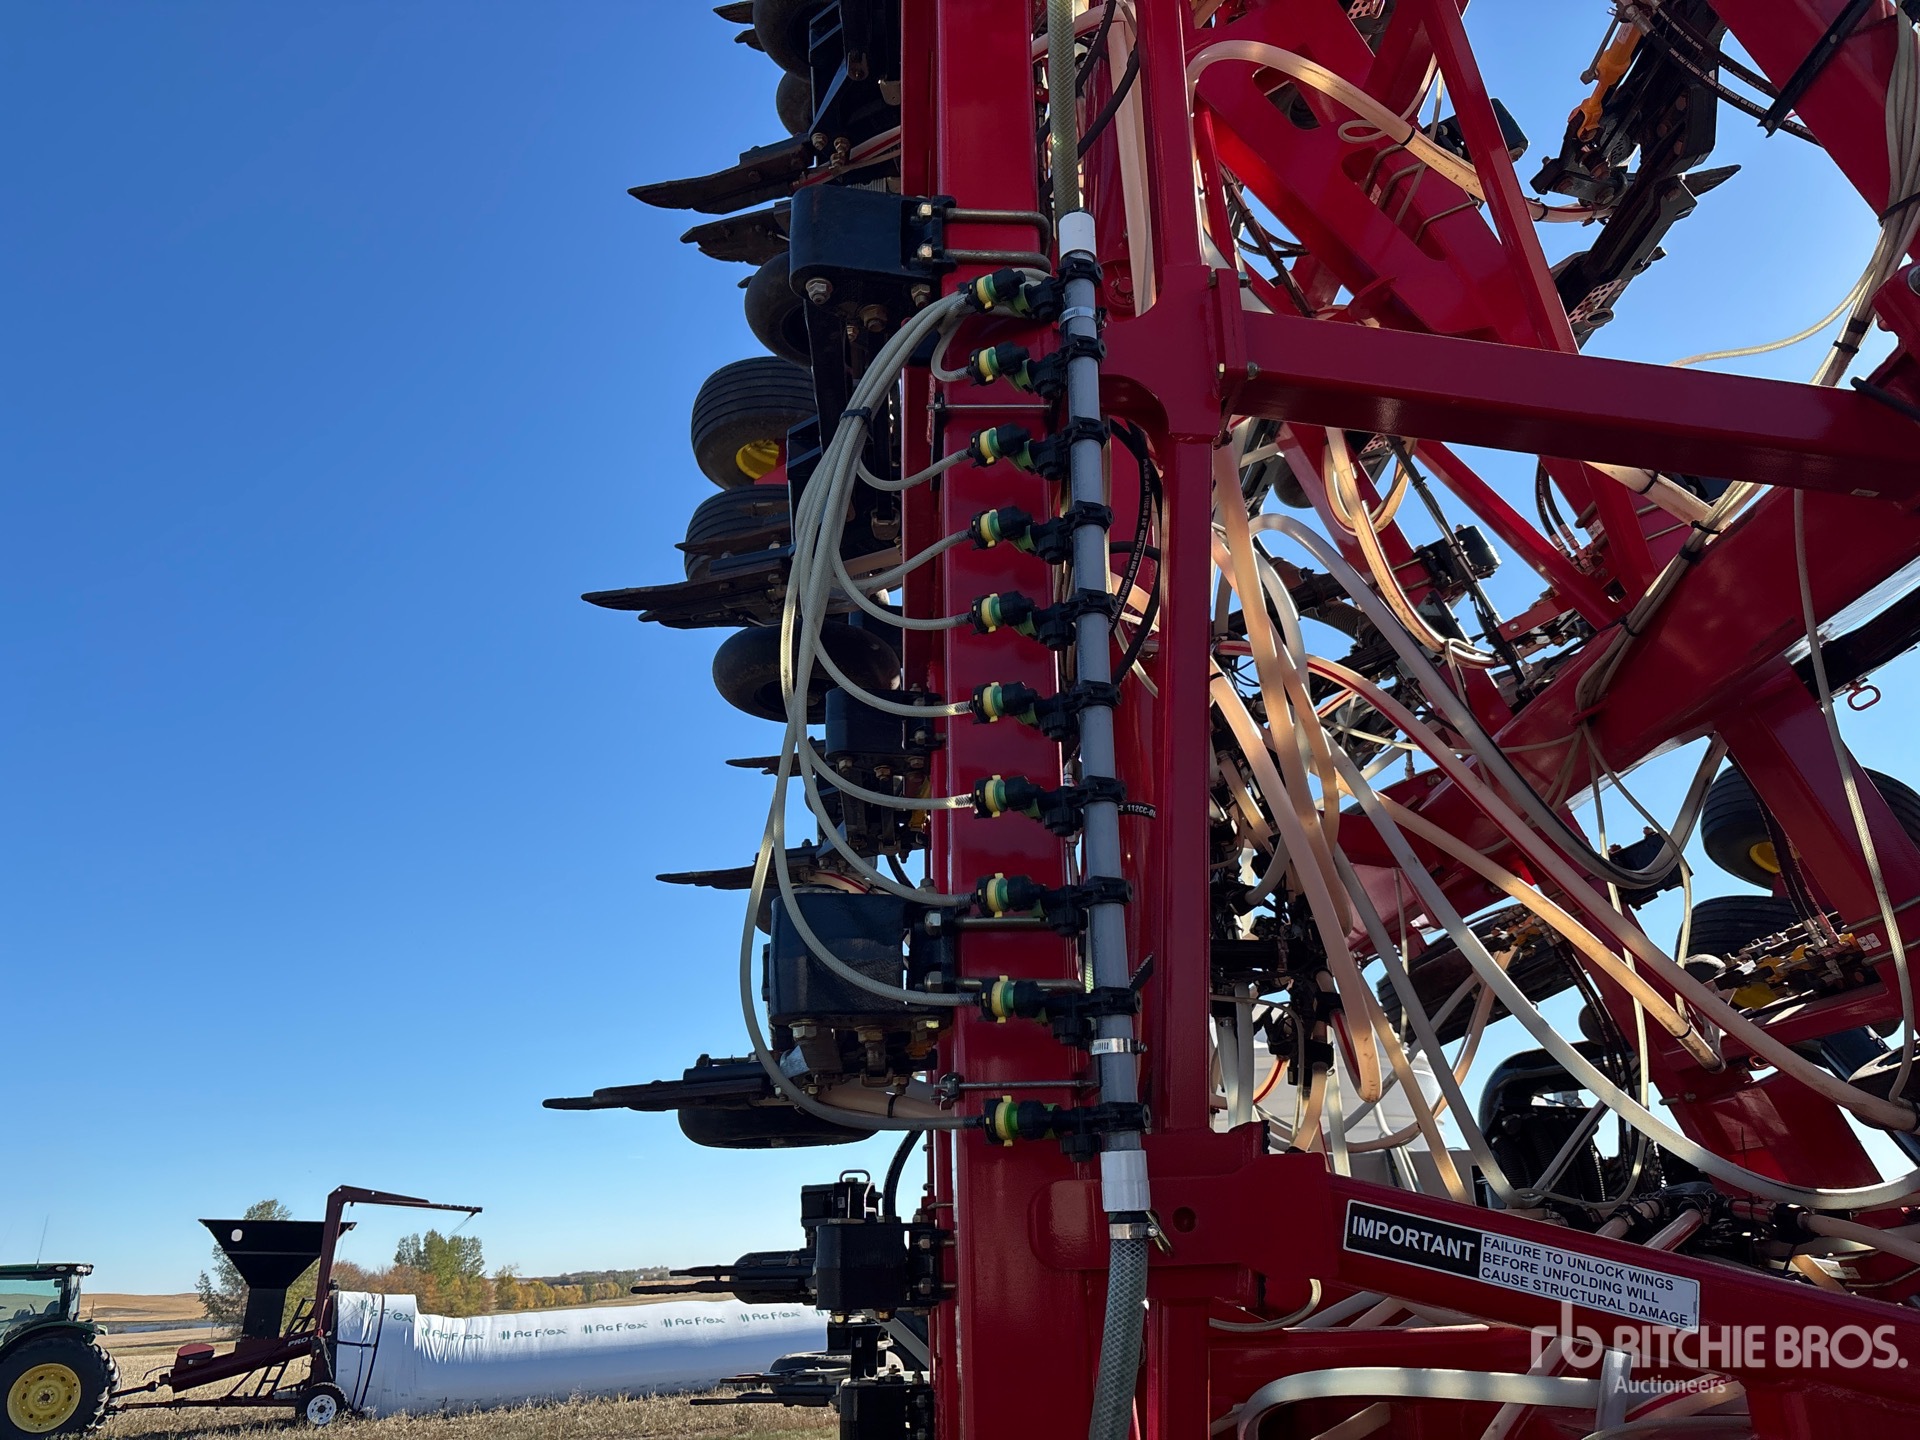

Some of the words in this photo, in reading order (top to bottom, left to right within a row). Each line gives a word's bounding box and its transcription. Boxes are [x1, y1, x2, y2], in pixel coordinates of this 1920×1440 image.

[1352, 1215, 1475, 1262] IMPORTANT
[1483, 1236, 1541, 1260] FAILURE
[1545, 1251, 1564, 1265] TO
[1567, 1256, 1625, 1280] UNLOCK
[1628, 1270, 1674, 1291] WINGS
[1481, 1267, 1529, 1288] CAUSE
[1532, 1279, 1625, 1311] STRUCTURAL
[1628, 1302, 1693, 1328] DAMAGE.
[1482, 1251, 1539, 1275] BEFORE
[1542, 1265, 1622, 1295] UNFOLDING
[1626, 1285, 1659, 1304] WILL
